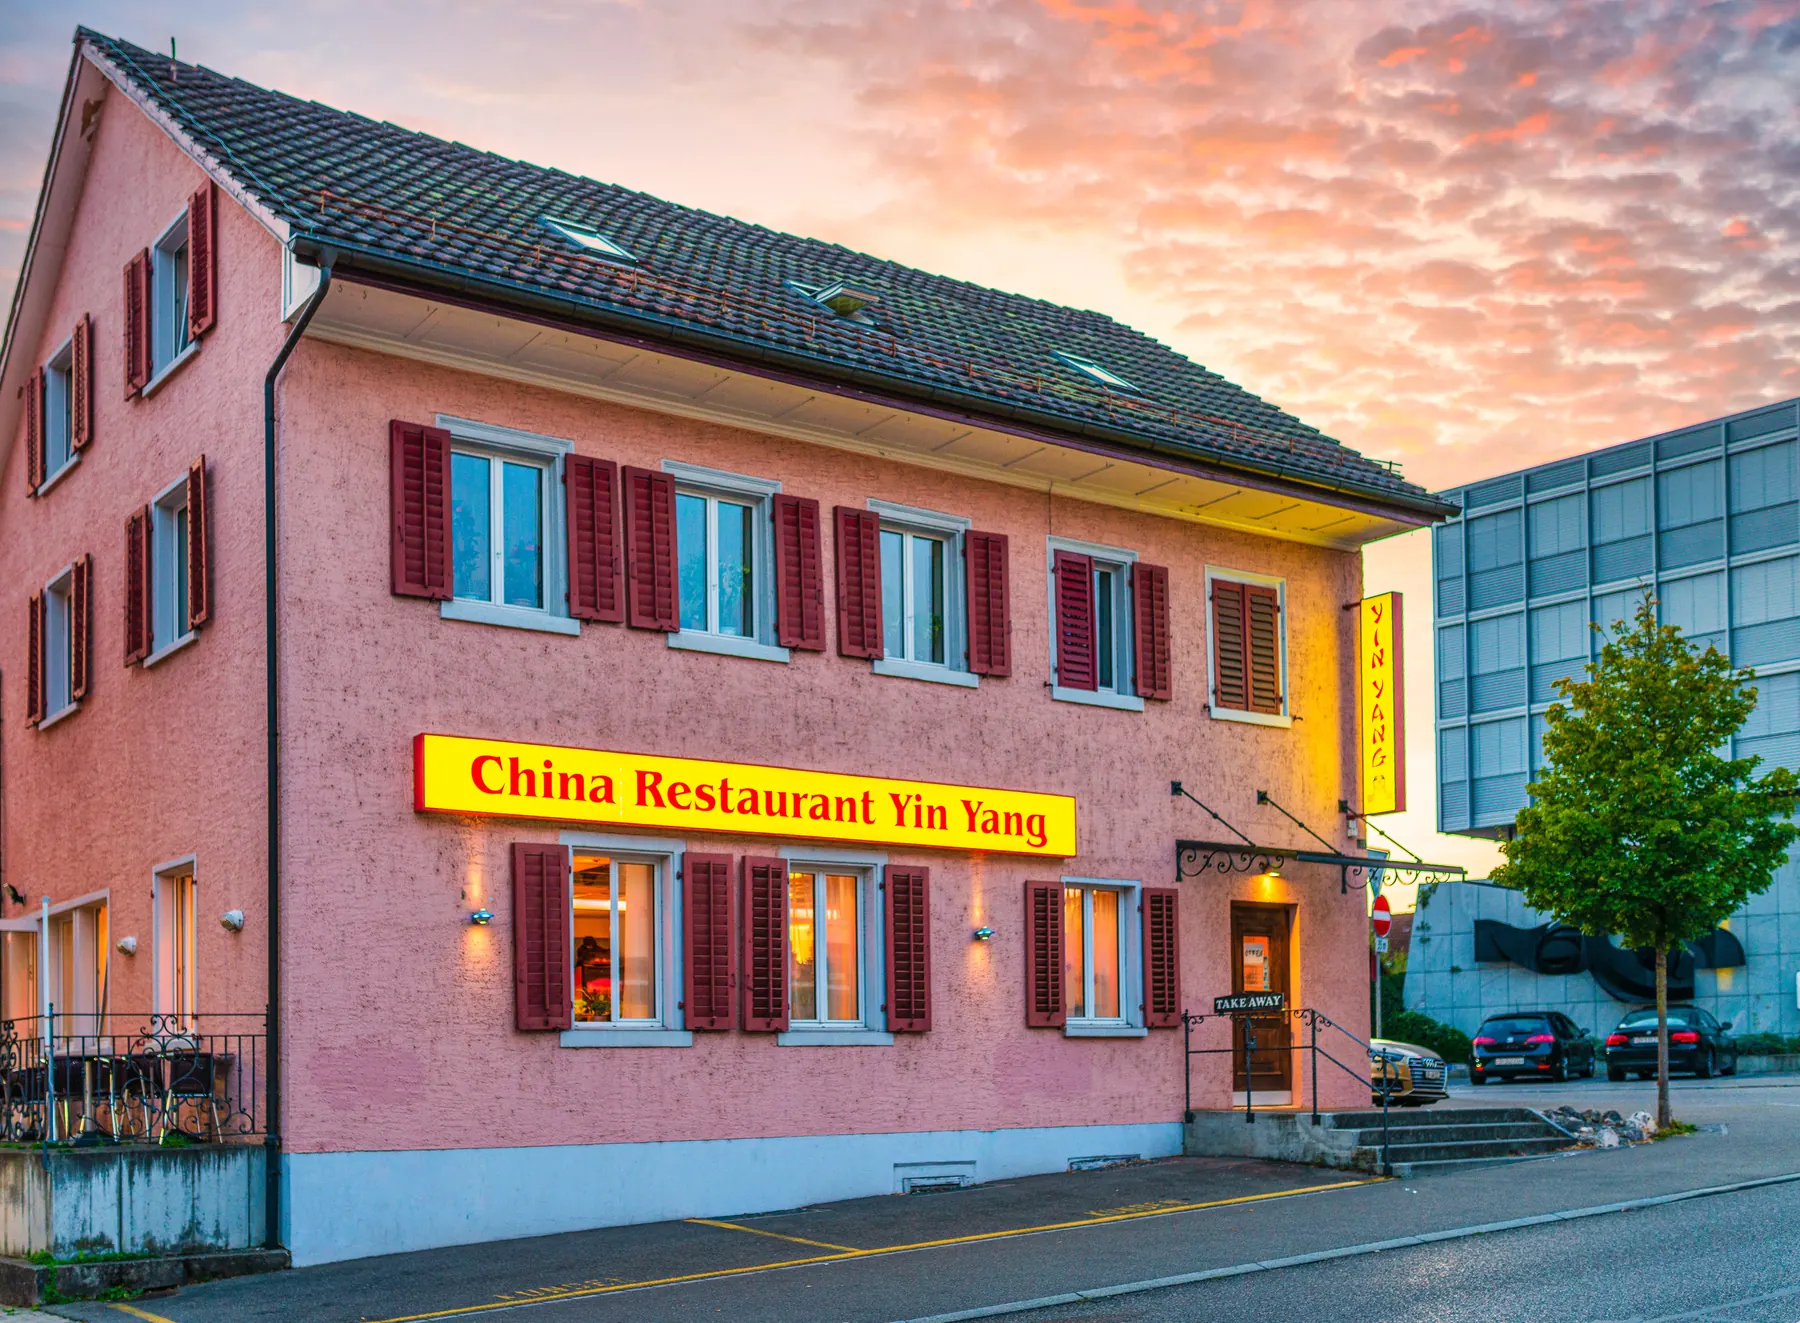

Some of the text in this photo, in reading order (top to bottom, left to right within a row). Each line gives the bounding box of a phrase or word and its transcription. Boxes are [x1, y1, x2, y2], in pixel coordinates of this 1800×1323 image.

[1370, 602, 1386, 767] YIN YANG
[470, 755, 1048, 848] China Restaurant Yin Yang
